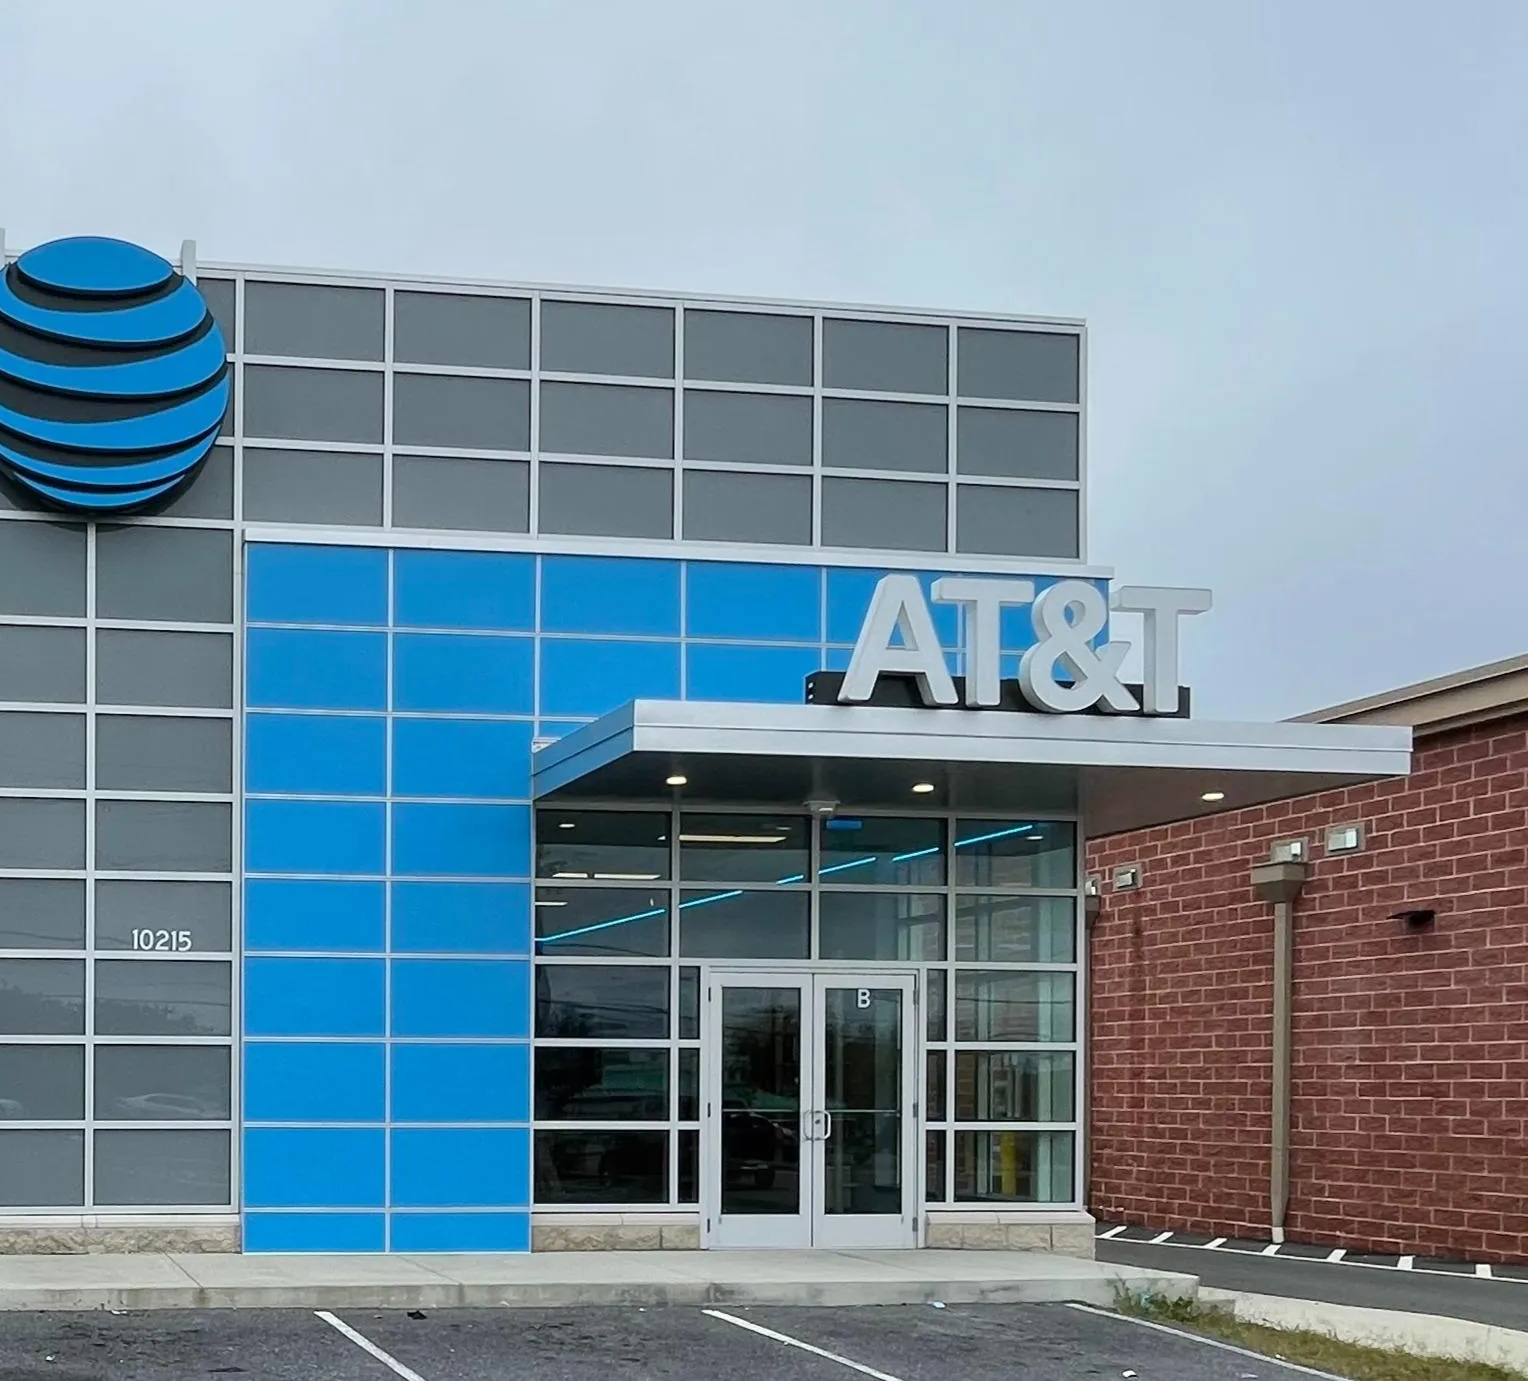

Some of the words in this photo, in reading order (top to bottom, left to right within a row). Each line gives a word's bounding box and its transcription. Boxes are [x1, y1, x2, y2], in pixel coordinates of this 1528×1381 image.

[837, 573, 1213, 714] AT&T
[132, 929, 192, 952] 10215
[857, 989, 871, 1009] B
